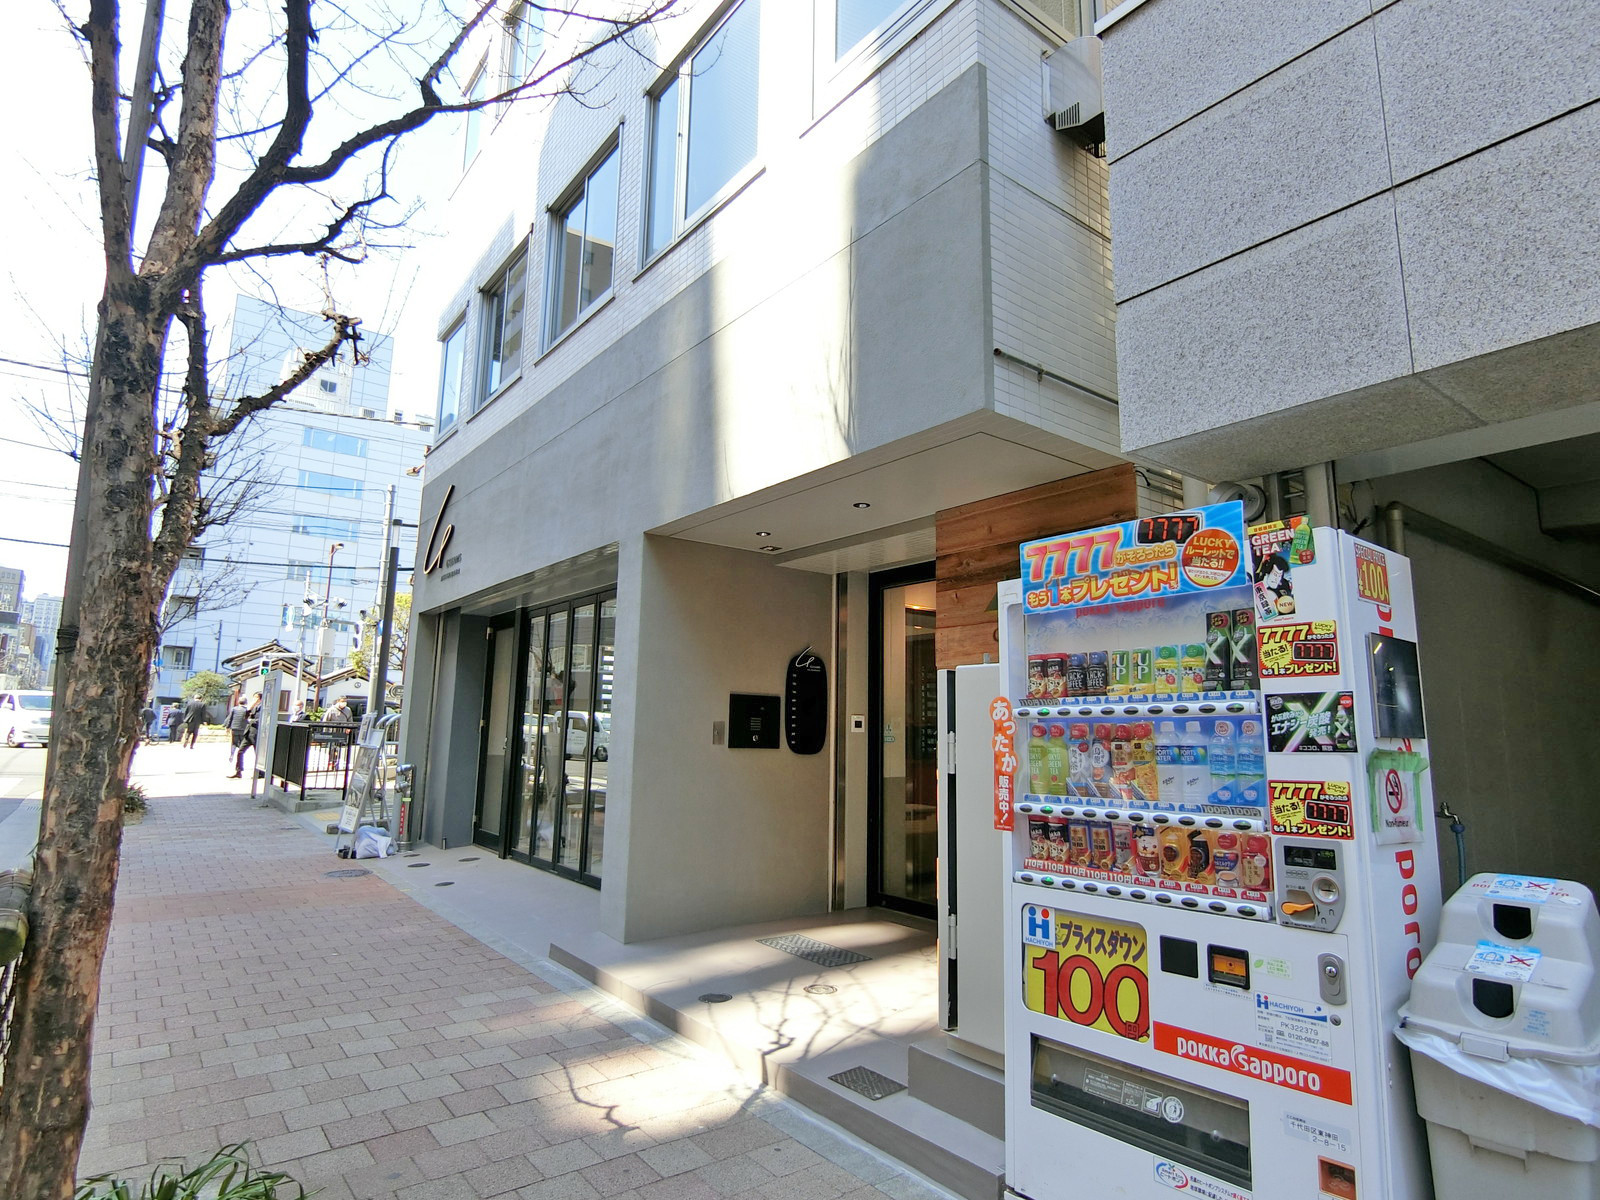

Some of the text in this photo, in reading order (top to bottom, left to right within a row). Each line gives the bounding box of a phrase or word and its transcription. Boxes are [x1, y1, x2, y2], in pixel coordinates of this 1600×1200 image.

[1193, 536, 1231, 548] LUCKY
[1252, 529, 1295, 545] GREEN
[1186, 546, 1235, 559] ルーレットで
[1254, 543, 1280, 555] TEA
[1263, 645, 1289, 659] 当たる!
[1296, 644, 1333, 658] 7777
[1203, 804, 1230, 815] 100円
[1231, 806, 1259, 817] 100円
[1274, 802, 1300, 815] 当たる!
[1308, 803, 1347, 821] 7777
[1025, 859, 1044, 868] 110円
[1044, 861, 1064, 873] 110円
[1065, 865, 1086, 877] 110円
[1086, 869, 1108, 881] 110円
[1109, 873, 1132, 885] 110円
[1025, 937, 1054, 947] HACHIYOH
[1060, 920, 1146, 963] プライスダウン
[1269, 1001, 1304, 1013] HACHIYOH
[1280, 1021, 1318, 1036] PK322379
[1230, 1044, 1321, 1092] sapporo
[1290, 1121, 1339, 1142] 千代田区東神田
